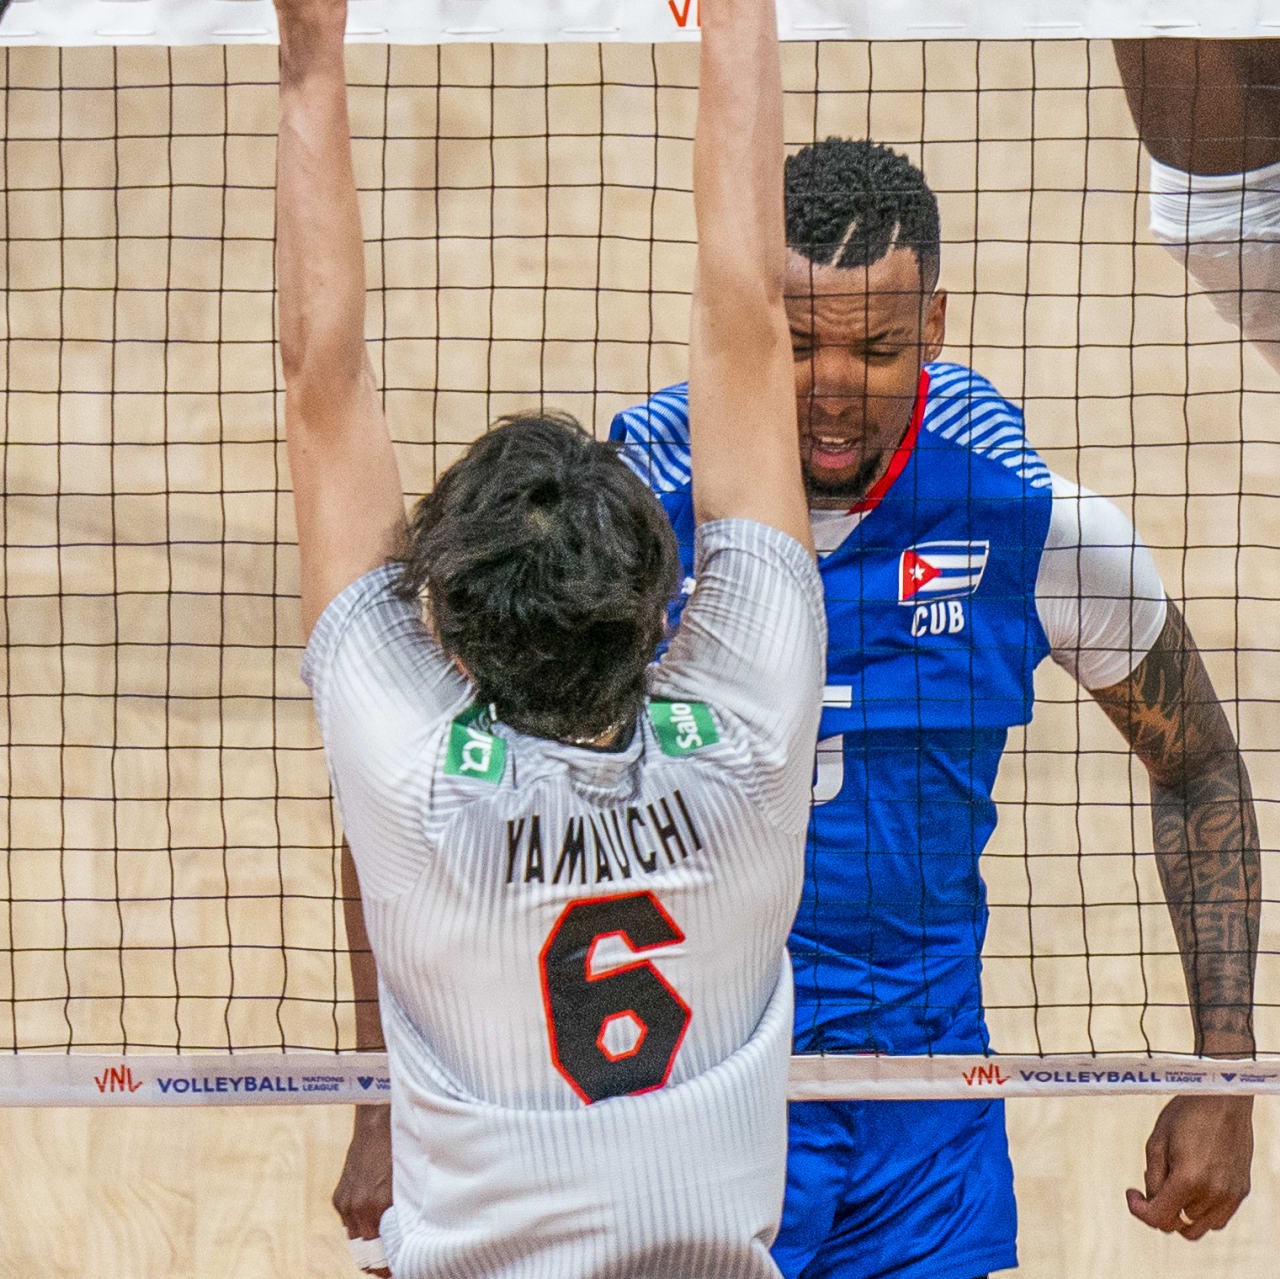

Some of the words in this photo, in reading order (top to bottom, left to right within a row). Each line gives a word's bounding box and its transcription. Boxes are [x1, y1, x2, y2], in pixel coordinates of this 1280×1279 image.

[911, 600, 966, 637] CUB
[506, 789, 704, 885] YAMAUCHI
[538, 889, 693, 1106] 6
[93, 1063, 143, 1093] VNL
[157, 1076, 298, 1093] VOLLEYBALL
[302, 1083, 340, 1091] LEAGUE
[962, 1063, 1010, 1086] VNL
[1020, 1069, 1161, 1084] VOLLEYBALL
